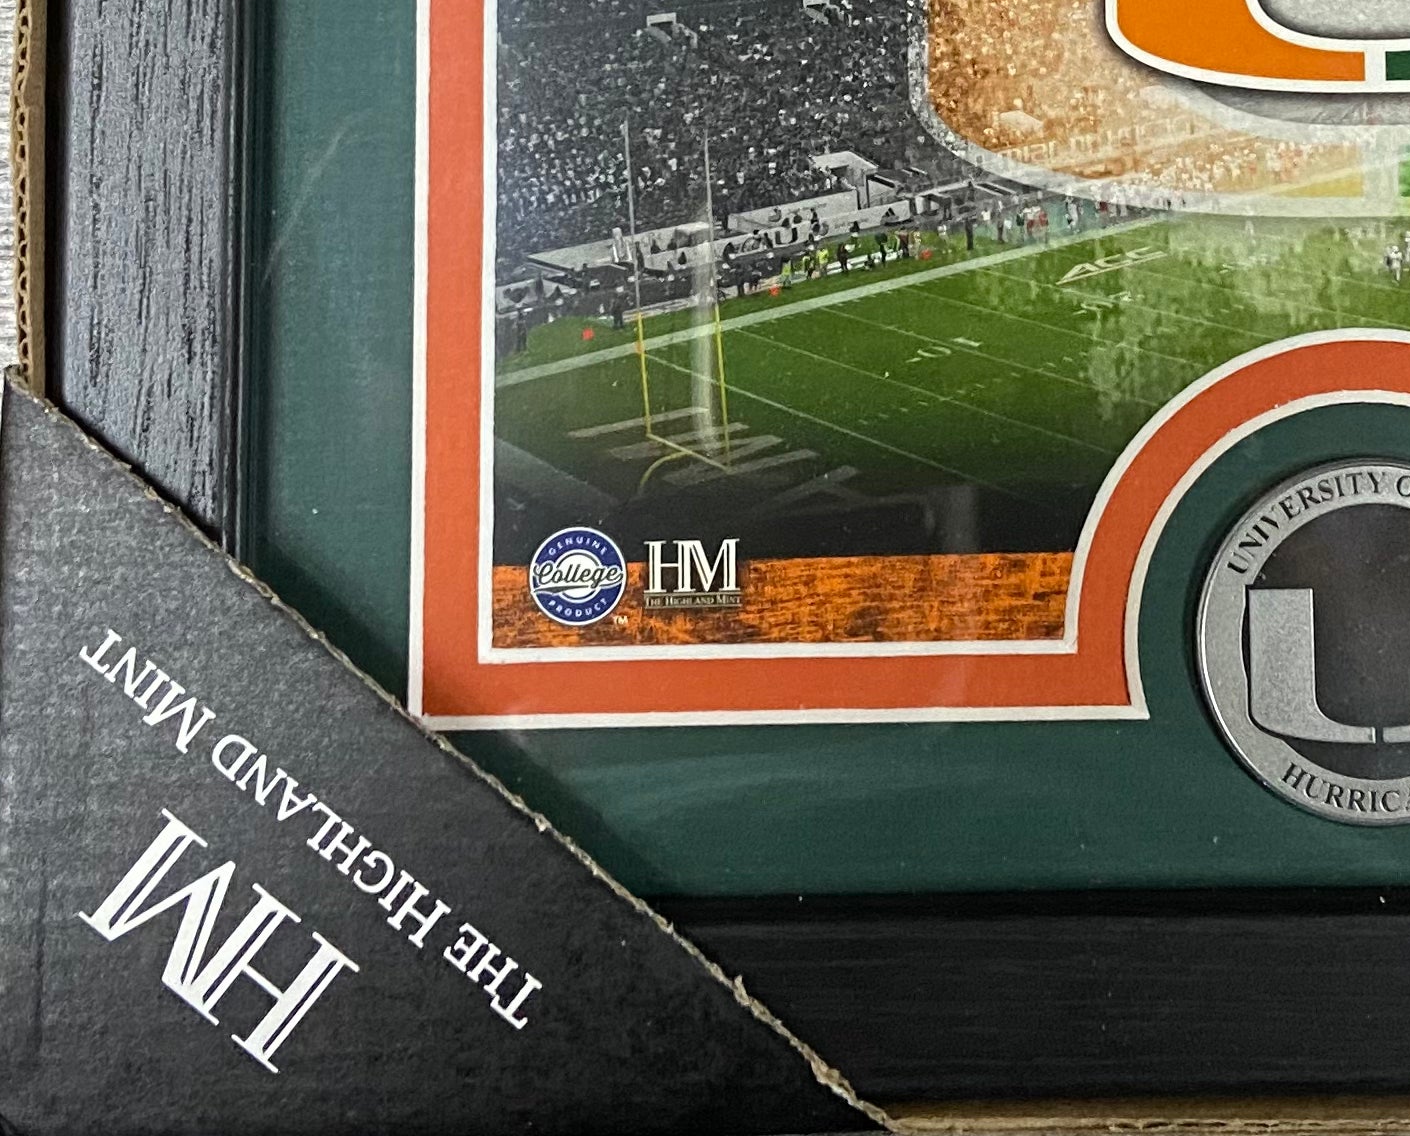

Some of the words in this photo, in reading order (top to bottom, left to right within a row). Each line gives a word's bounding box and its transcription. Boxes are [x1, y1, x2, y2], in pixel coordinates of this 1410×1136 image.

[1226, 471, 1387, 577] UNIVERSITY
[548, 536, 608, 557] GENUINE
[643, 538, 741, 593] HM
[533, 563, 623, 589] College
[547, 597, 609, 618] PRODUCT
[78, 807, 361, 1074] HM
